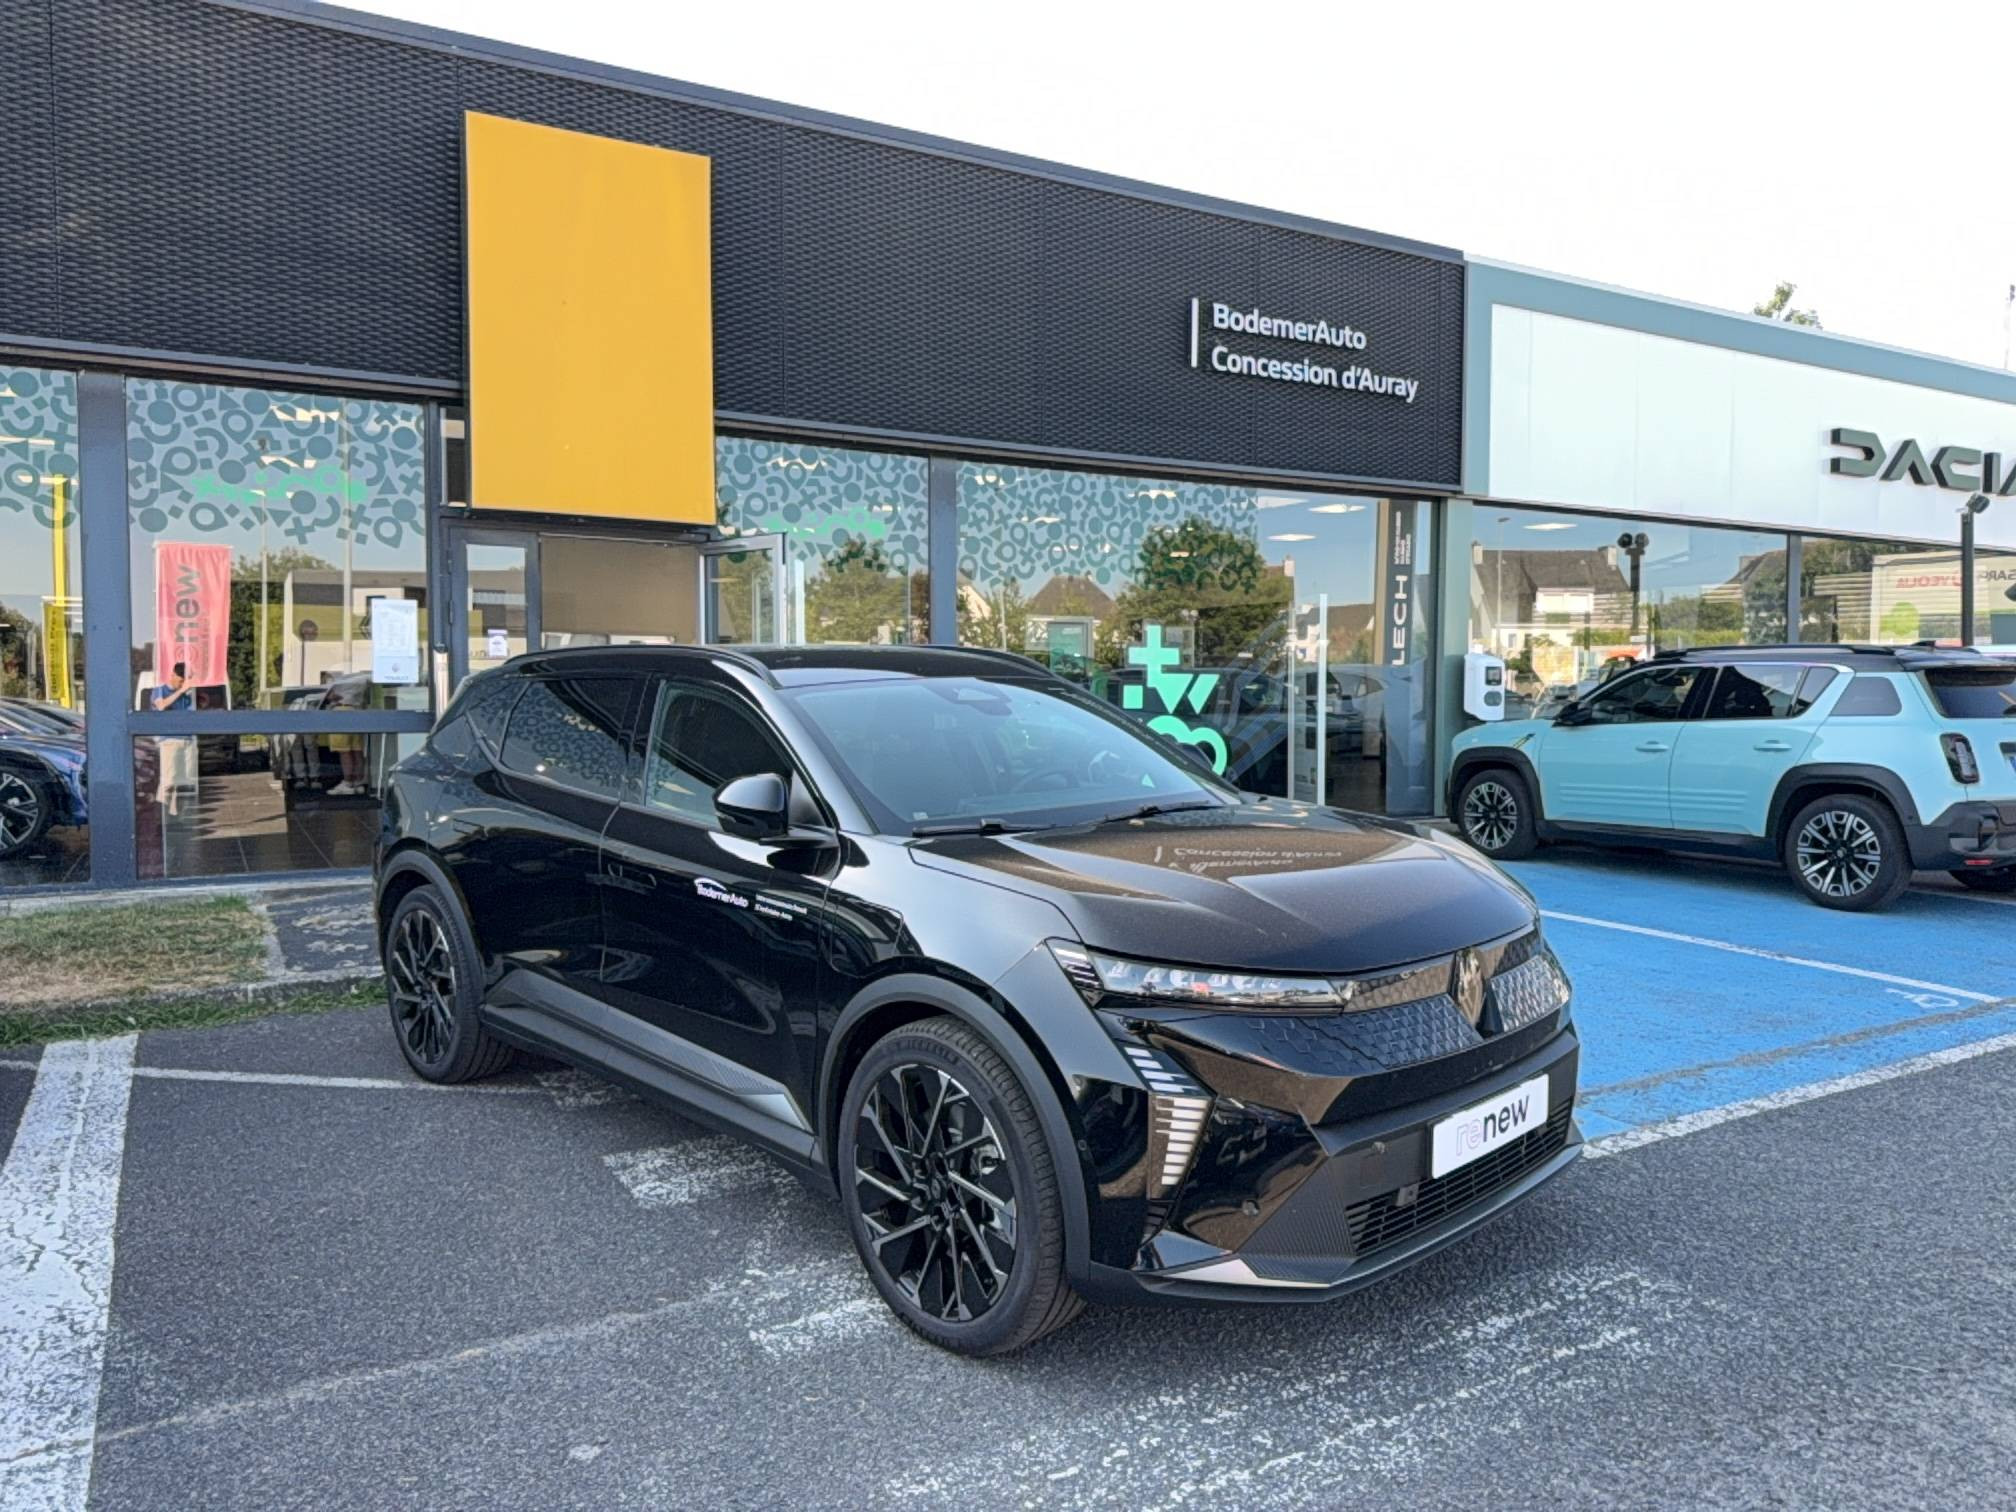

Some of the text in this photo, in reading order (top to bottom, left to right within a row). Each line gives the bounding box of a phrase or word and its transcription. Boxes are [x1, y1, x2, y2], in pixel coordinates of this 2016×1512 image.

[1212, 303, 1367, 350] BodemerAuto
[1211, 345, 1419, 403] Concession d'Auray
[1456, 1095, 1529, 1157] renew
